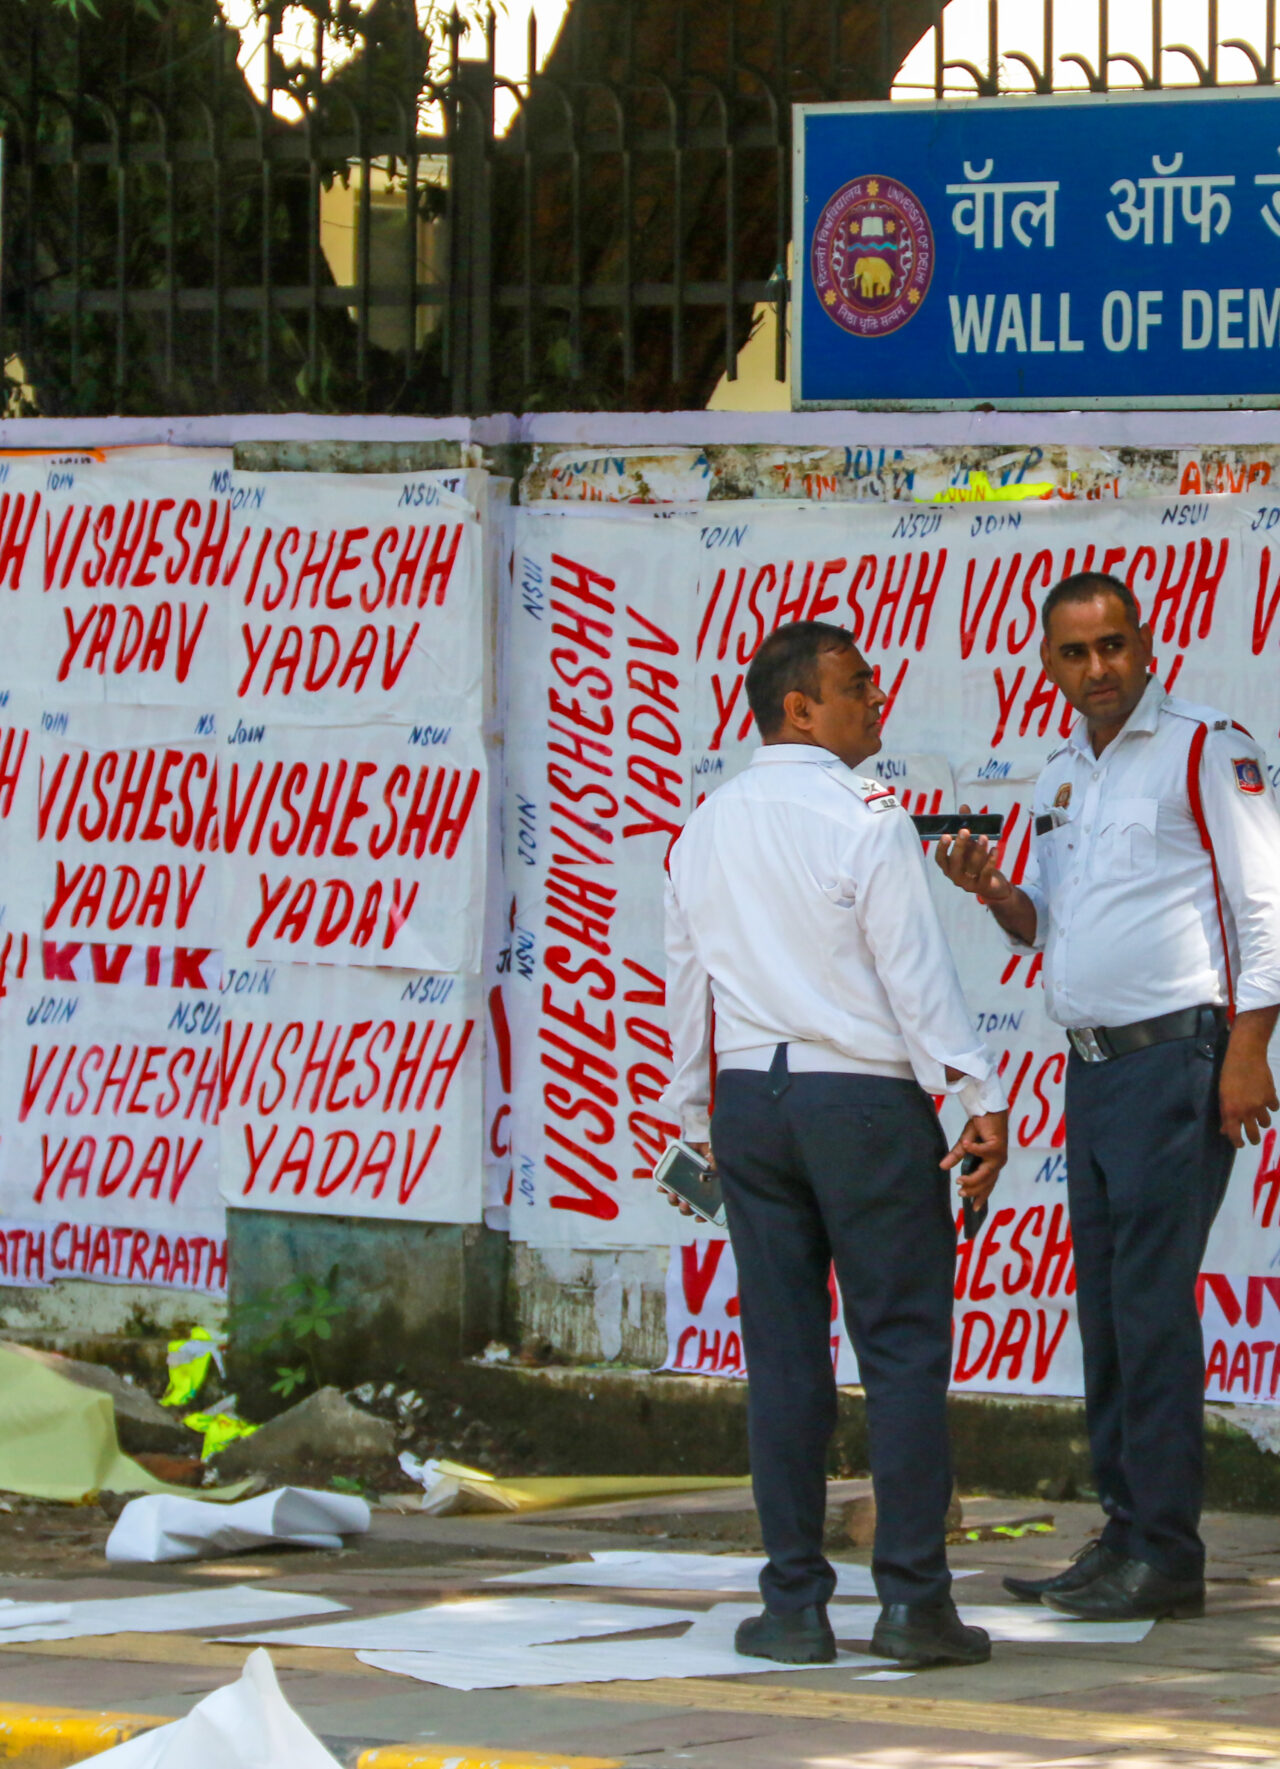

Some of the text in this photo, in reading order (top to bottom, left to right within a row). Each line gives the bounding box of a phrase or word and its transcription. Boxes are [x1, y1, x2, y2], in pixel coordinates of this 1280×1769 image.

[888, 185, 929, 284] UNIVERSITY OF DELHI
[946, 159, 1060, 249] वॉल
[1105, 152, 1236, 245] ऑफ
[948, 293, 1084, 355] WALL
[1101, 290, 1163, 351] OF
[892, 513, 943, 539] NSUI
[970, 502, 1209, 537] JOIN NSUI
[56, 602, 208, 682] YADAV
[237, 622, 421, 697] YADAV
[227, 718, 451, 746] JOIN NSUI
[514, 556, 543, 866] JOIN NSUI
[545, 552, 619, 866] VISHESHH
[622, 604, 684, 875] YADAV
[876, 761, 907, 779] NSUI
[976, 760, 1012, 779] JOIN
[224, 759, 481, 860] VISHESHH
[44, 861, 206, 931] YADAV
[247, 873, 419, 949] YADAV
[27, 998, 77, 1026] JOIN
[222, 969, 454, 1004] JOIN NSUI
[218, 1019, 475, 1115] VISHESHH
[537, 854, 620, 1222] VISHESHH
[33, 1134, 204, 1204] YADAV
[243, 1124, 441, 1206] YADAV
[51, 1222, 227, 1289] CHATRAATH
